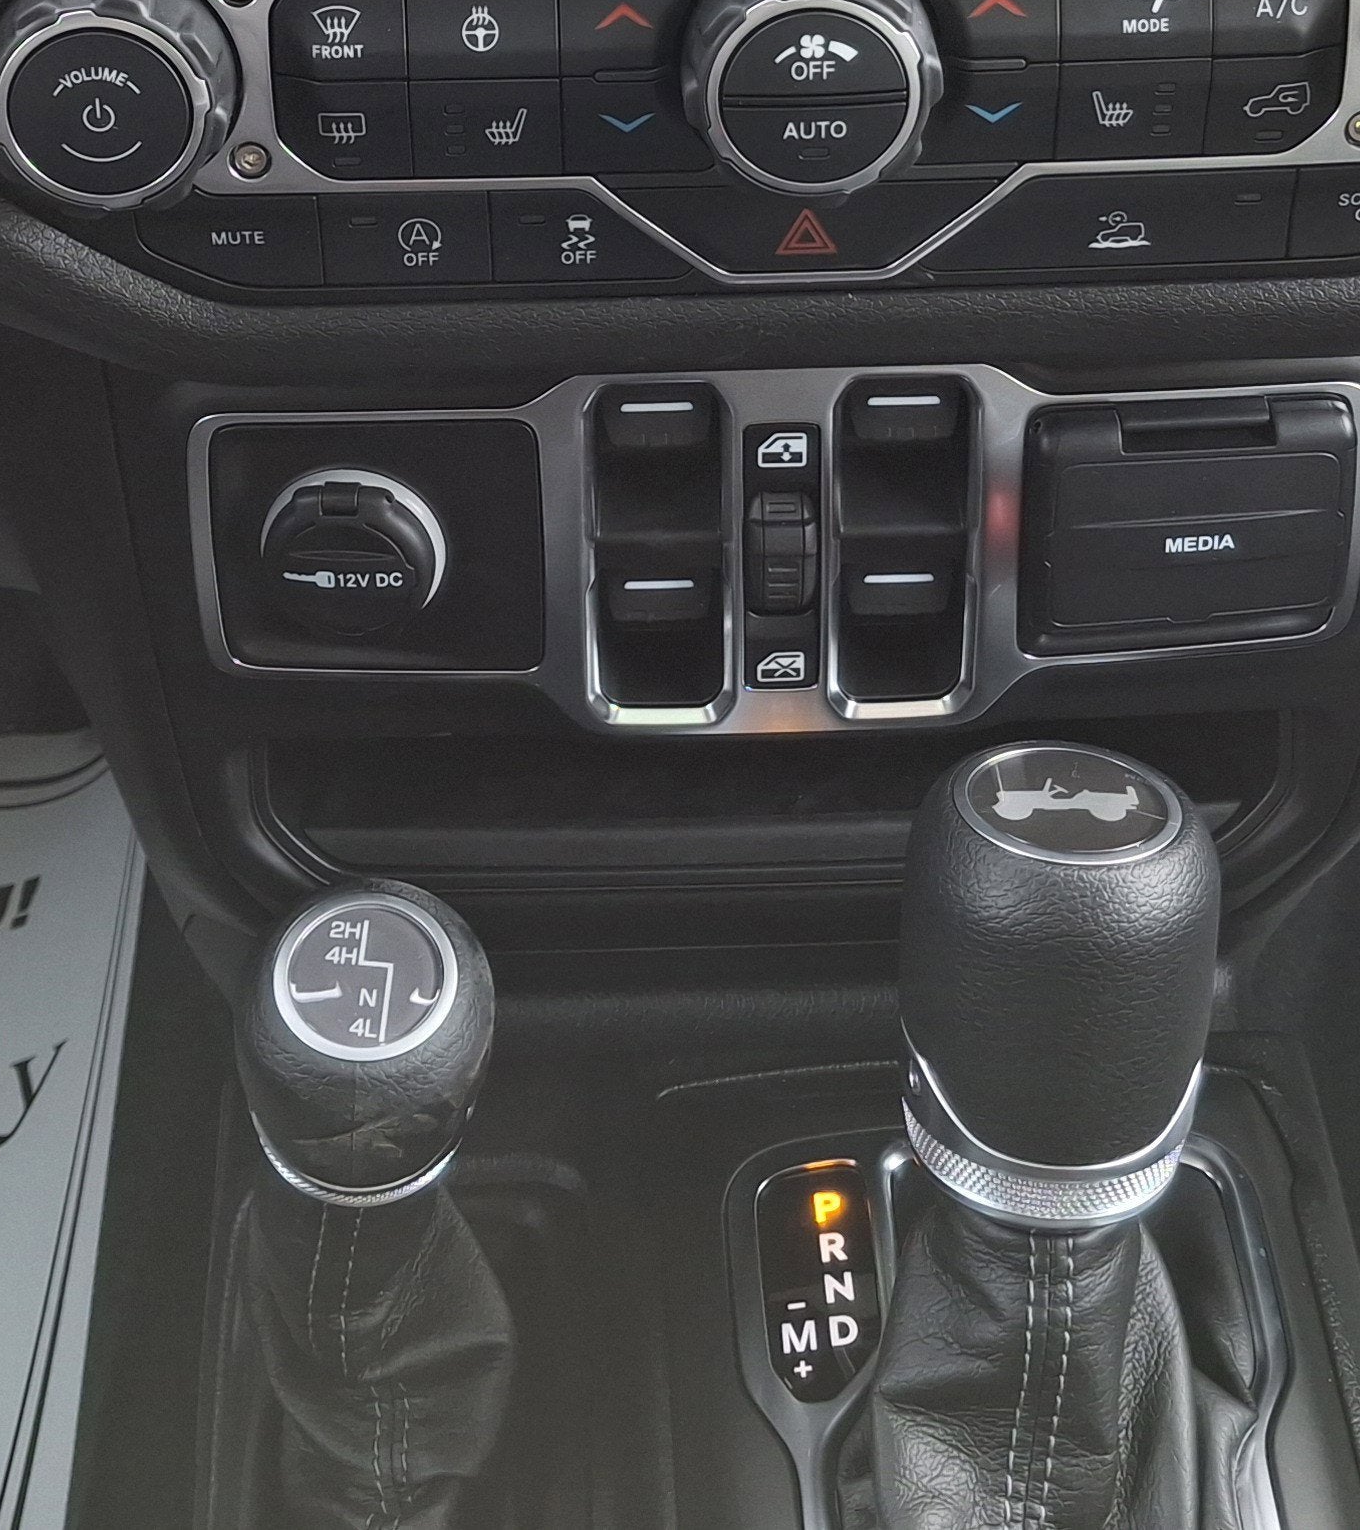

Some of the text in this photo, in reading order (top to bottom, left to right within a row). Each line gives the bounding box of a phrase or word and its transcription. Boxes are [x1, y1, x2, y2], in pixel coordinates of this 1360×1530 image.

[1123, 18, 1169, 34] MODE
[312, 44, 364, 59] FRONT
[60, 68, 128, 89] VOLUME
[791, 61, 836, 80] OFF
[783, 121, 847, 139] AUTO
[212, 230, 264, 246] MUTE
[403, 252, 439, 267] OFF
[561, 250, 597, 265] OFF
[1164, 534, 1235, 553] MEDIA
[337, 572, 403, 588] 12V DC
[329, 921, 361, 940] 2H
[325, 947, 358, 965] 4H
[359, 988, 377, 1007] N
[349, 1019, 377, 1038] 4L
[813, 1191, 841, 1224] P
[819, 1232, 848, 1263] R
[824, 1271, 854, 1303] N
[781, 1320, 817, 1354] M
[829, 1315, 858, 1347] D
